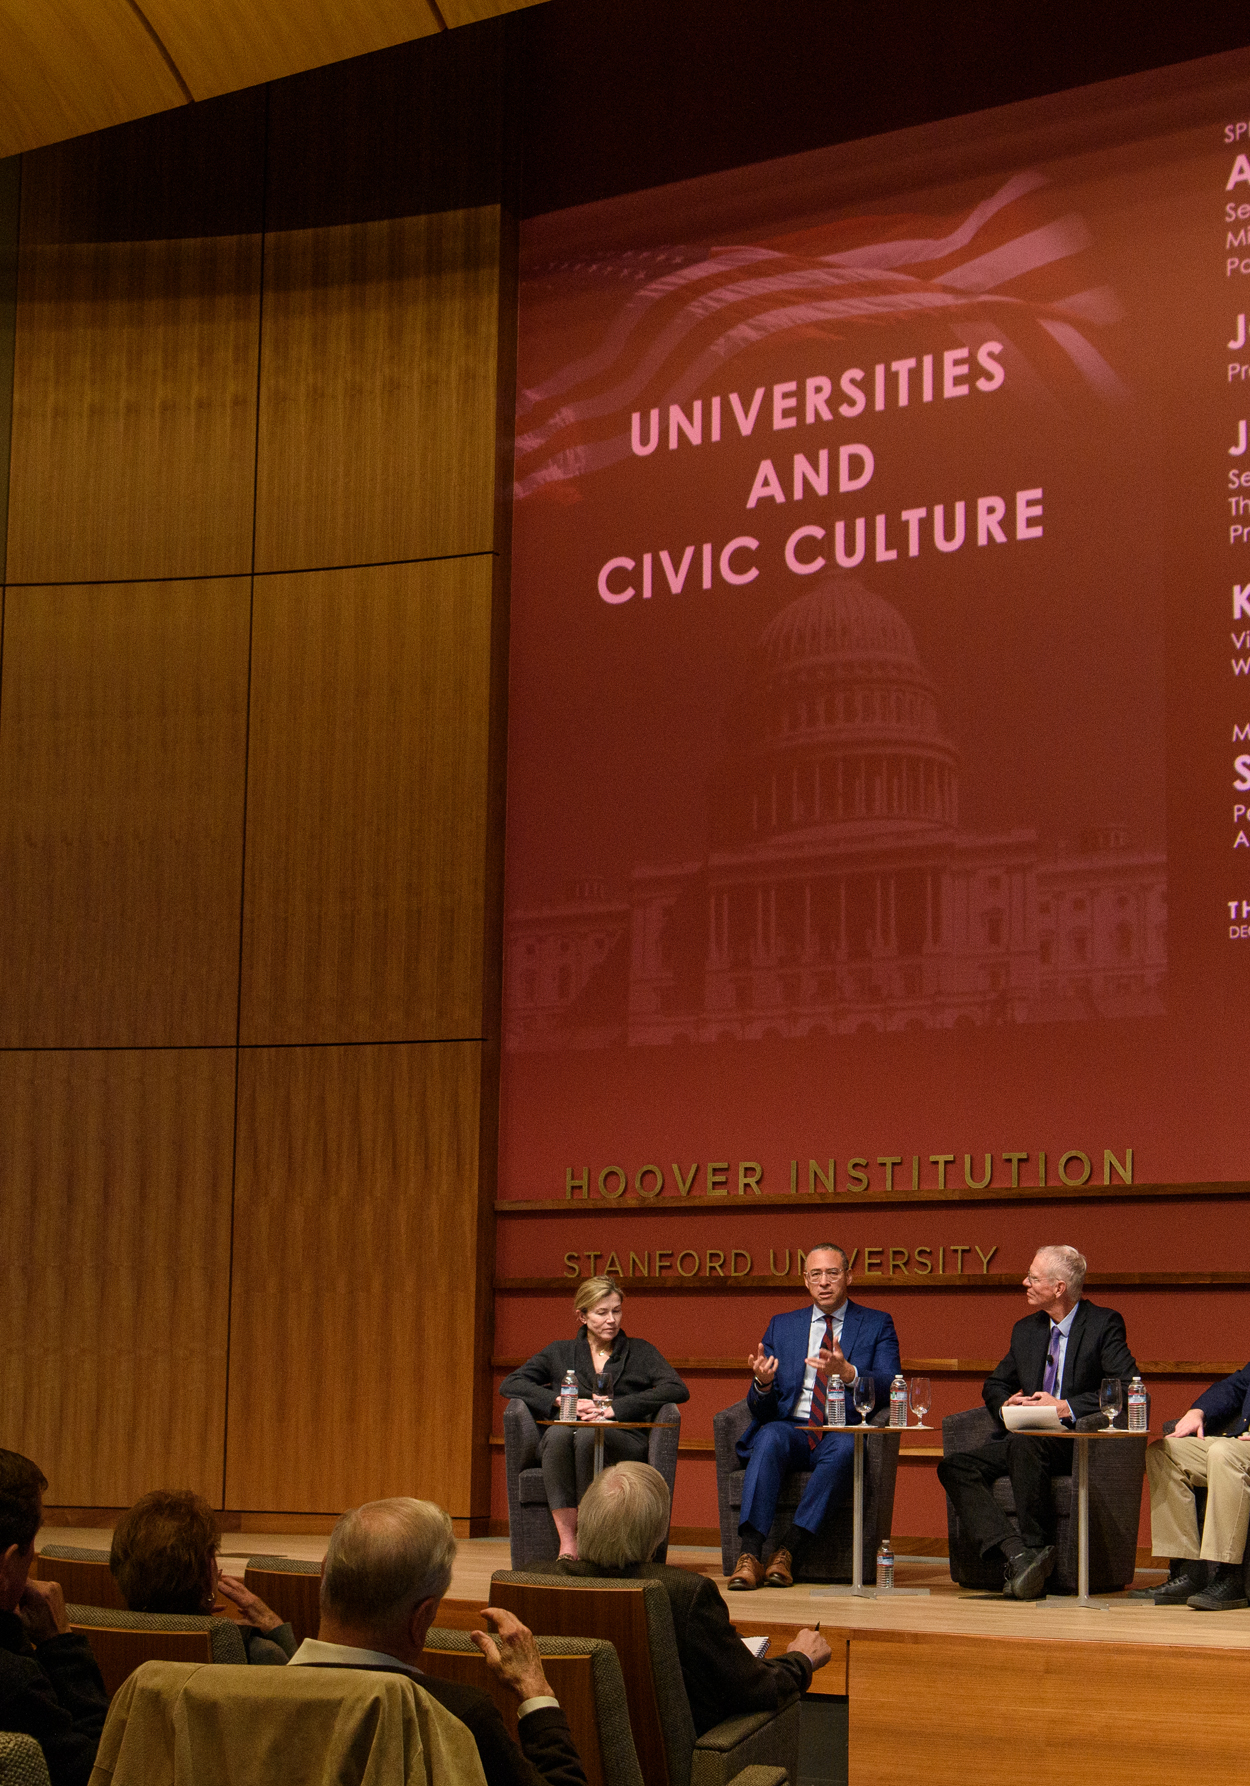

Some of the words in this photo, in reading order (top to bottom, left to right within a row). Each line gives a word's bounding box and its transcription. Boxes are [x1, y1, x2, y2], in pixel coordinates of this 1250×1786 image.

[630, 341, 1005, 456] UNIVERSITIES
[745, 444, 874, 509] AND
[597, 536, 759, 604] CIVIC
[784, 488, 1043, 575] CULTURE
[565, 1161, 764, 1200] HOOVER
[790, 1148, 1135, 1194] INSTITUTION
[563, 1249, 753, 1279] STANFORD
